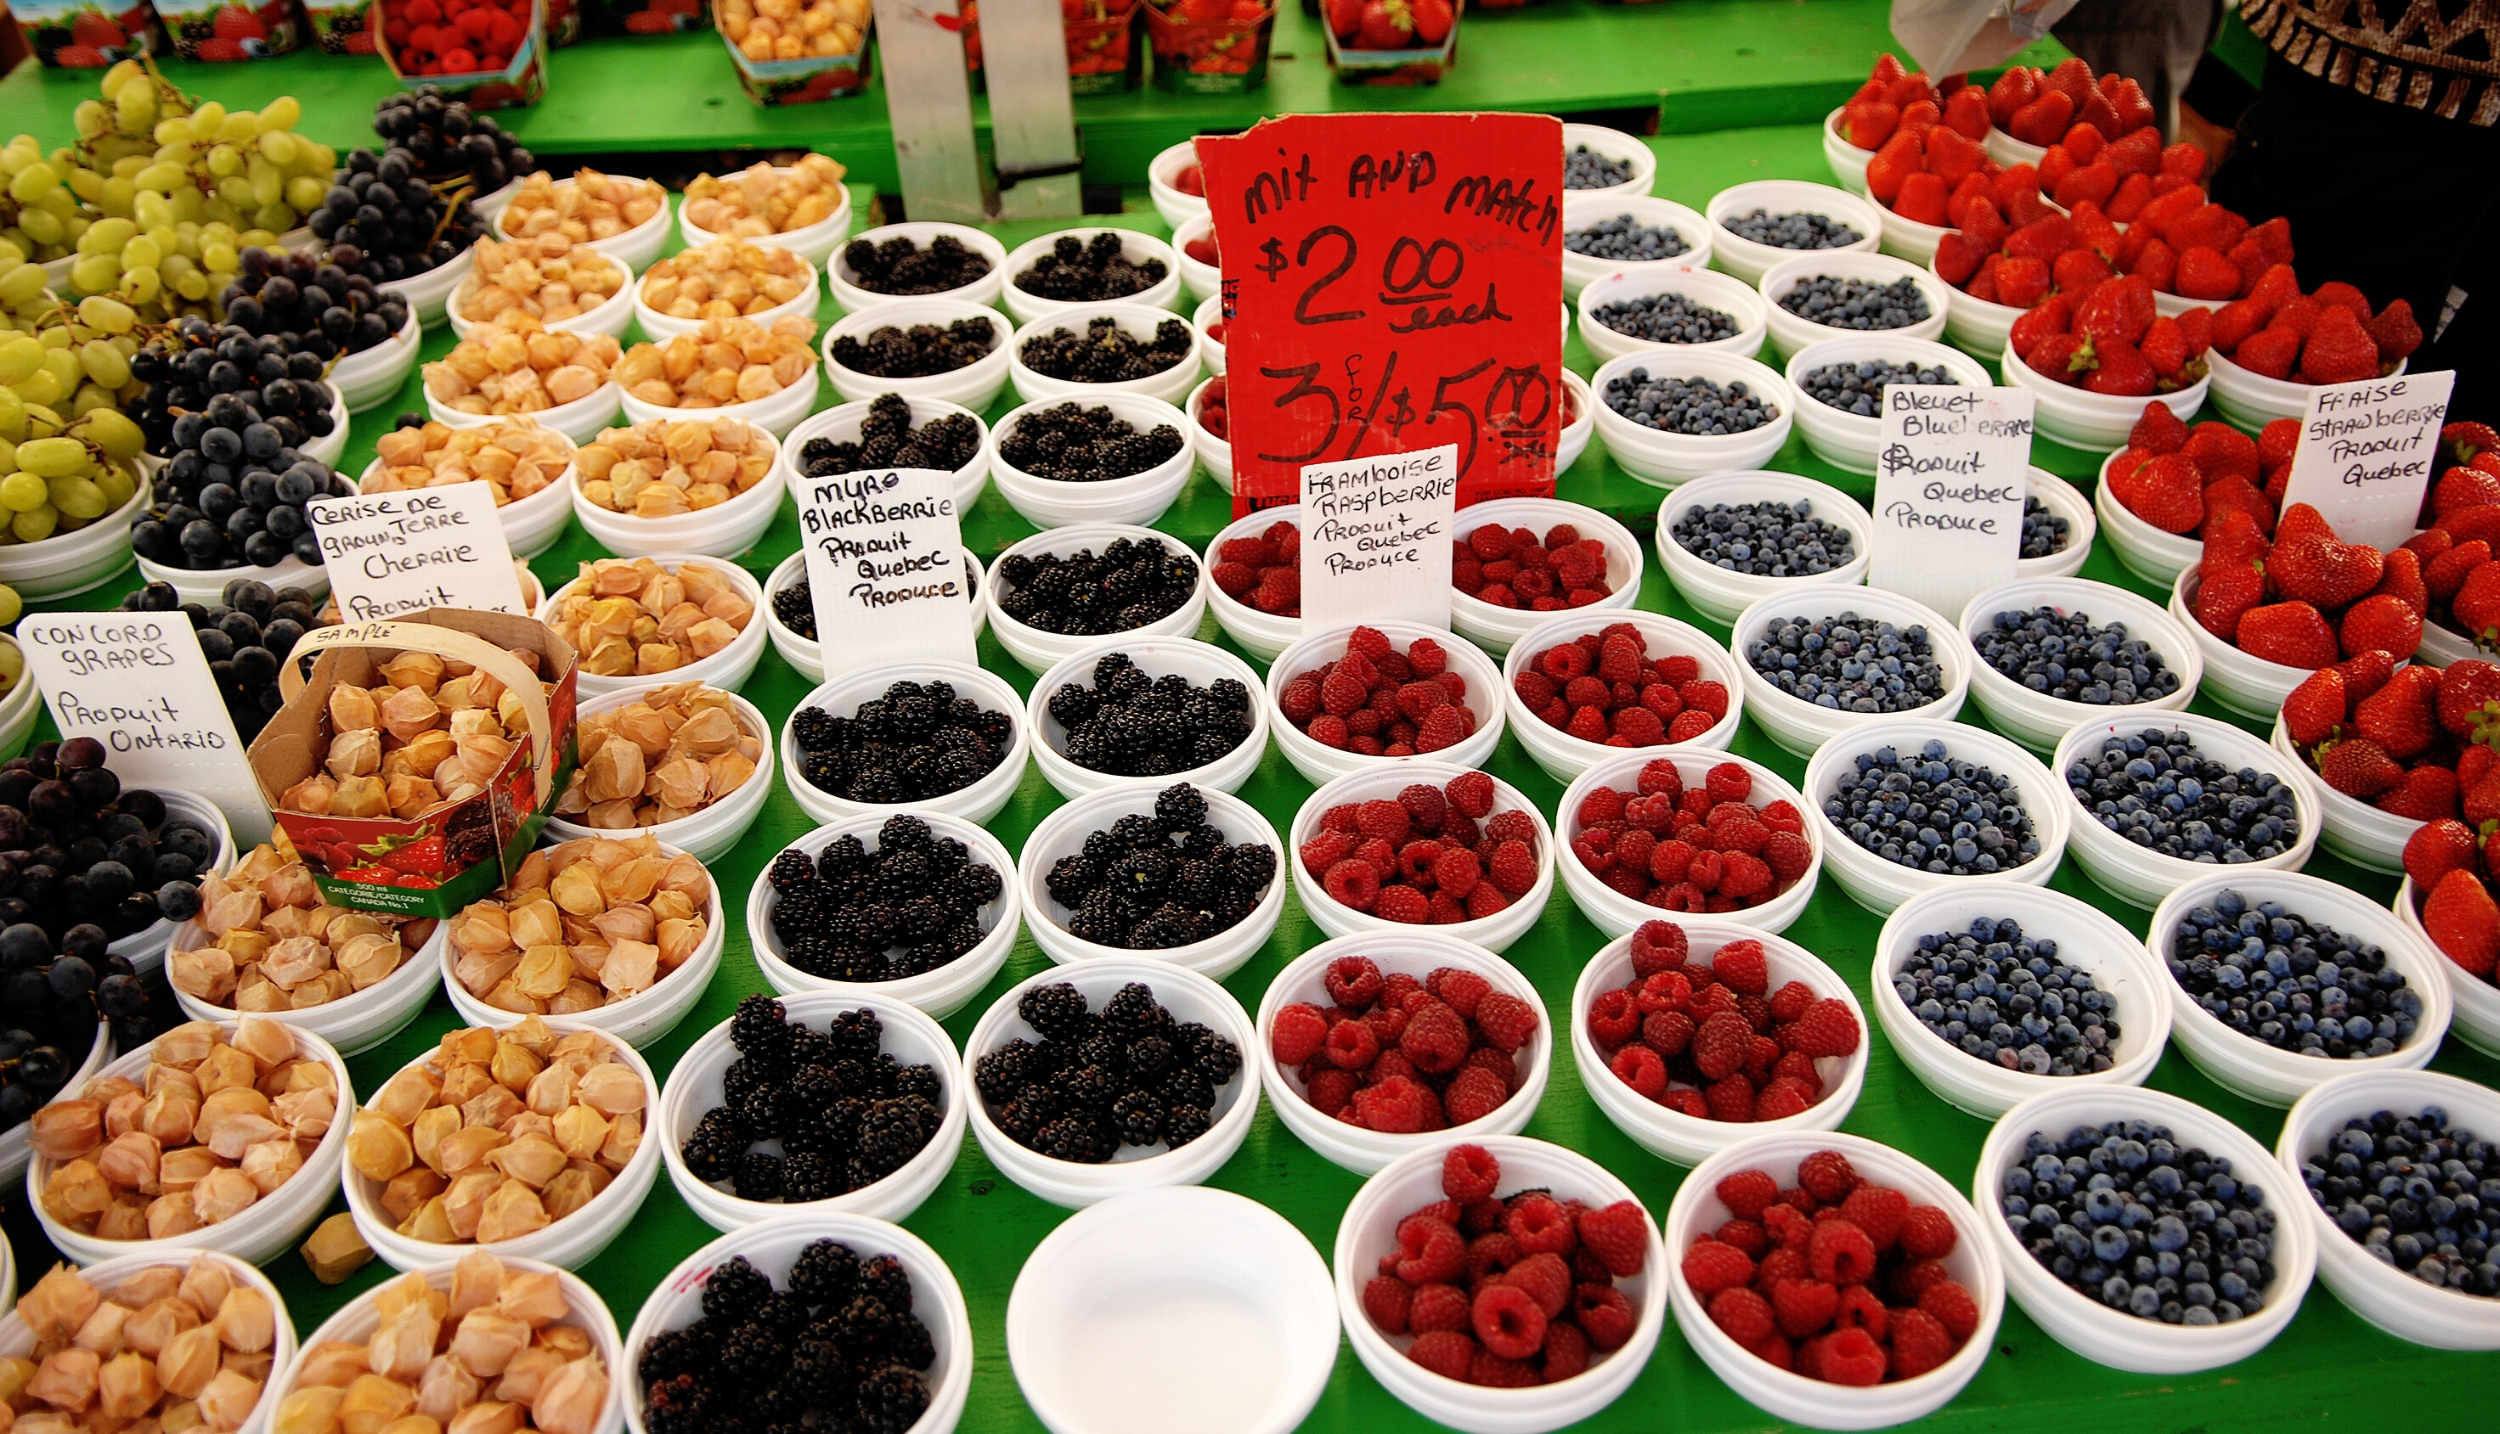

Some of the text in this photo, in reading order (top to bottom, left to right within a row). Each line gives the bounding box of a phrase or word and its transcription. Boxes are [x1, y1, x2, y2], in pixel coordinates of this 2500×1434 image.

[1349, 150, 1435, 198] AND
[1445, 175, 1557, 246] MAtch
[1389, 283, 1512, 333] each
[1892, 391, 1983, 412] Bleuet
[2329, 427, 2423, 463] PRODUIt
[1308, 455, 1443, 495] FRAMboise
[2343, 460, 2426, 487] Quebec
[1312, 477, 1455, 517] RAspbeRRie
[1923, 482, 2022, 503] Quebec
[311, 495, 446, 525] CeRiSe De
[389, 510, 469, 535] TeRRe
[802, 497, 953, 534] BlACKBeRRie
[1885, 501, 1998, 535] PRODuce
[1313, 512, 1412, 542] PRODuit
[1357, 521, 1441, 551] Quebec
[364, 544, 478, 579] CheRRie
[819, 531, 912, 566] PRODuit
[1324, 549, 1419, 577] PRODuce
[857, 550, 950, 581] Quebec
[349, 586, 455, 621] PRODuit
[848, 581, 959, 608] PRODuce
[32, 624, 162, 645] CONCORD
[61, 643, 175, 676] gRAPeS
[58, 691, 179, 727] PRODuit
[110, 725, 225, 752] ONtARiO
[351, 896, 388, 908] CANADA
[356, 883, 375, 891] 500
